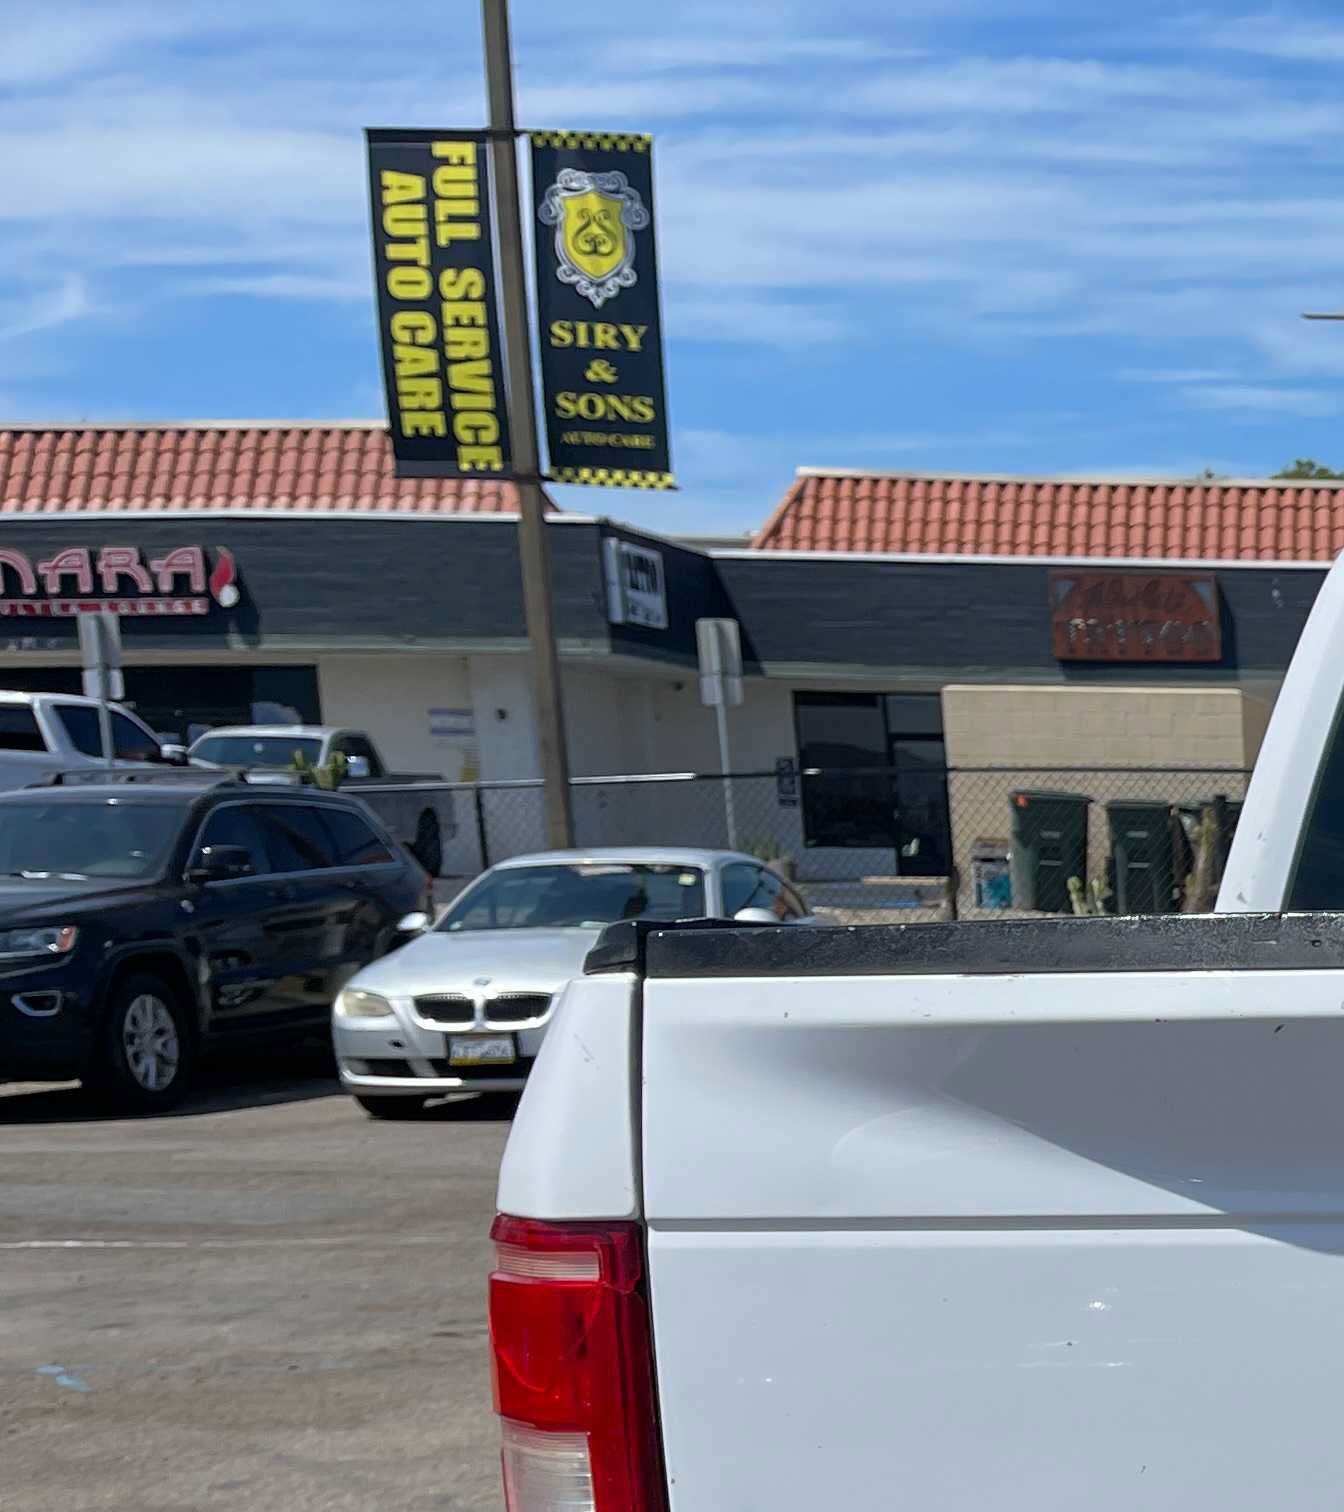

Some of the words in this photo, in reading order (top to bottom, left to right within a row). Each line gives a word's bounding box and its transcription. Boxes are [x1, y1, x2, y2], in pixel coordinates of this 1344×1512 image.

[380, 170, 433, 300] AUTO
[431, 141, 481, 248] FULL
[390, 311, 447, 438] CARE
[438, 267, 504, 472] SERVICE
[550, 320, 648, 352] SIRY
[584, 359, 618, 383] &
[555, 391, 655, 423] SONS
